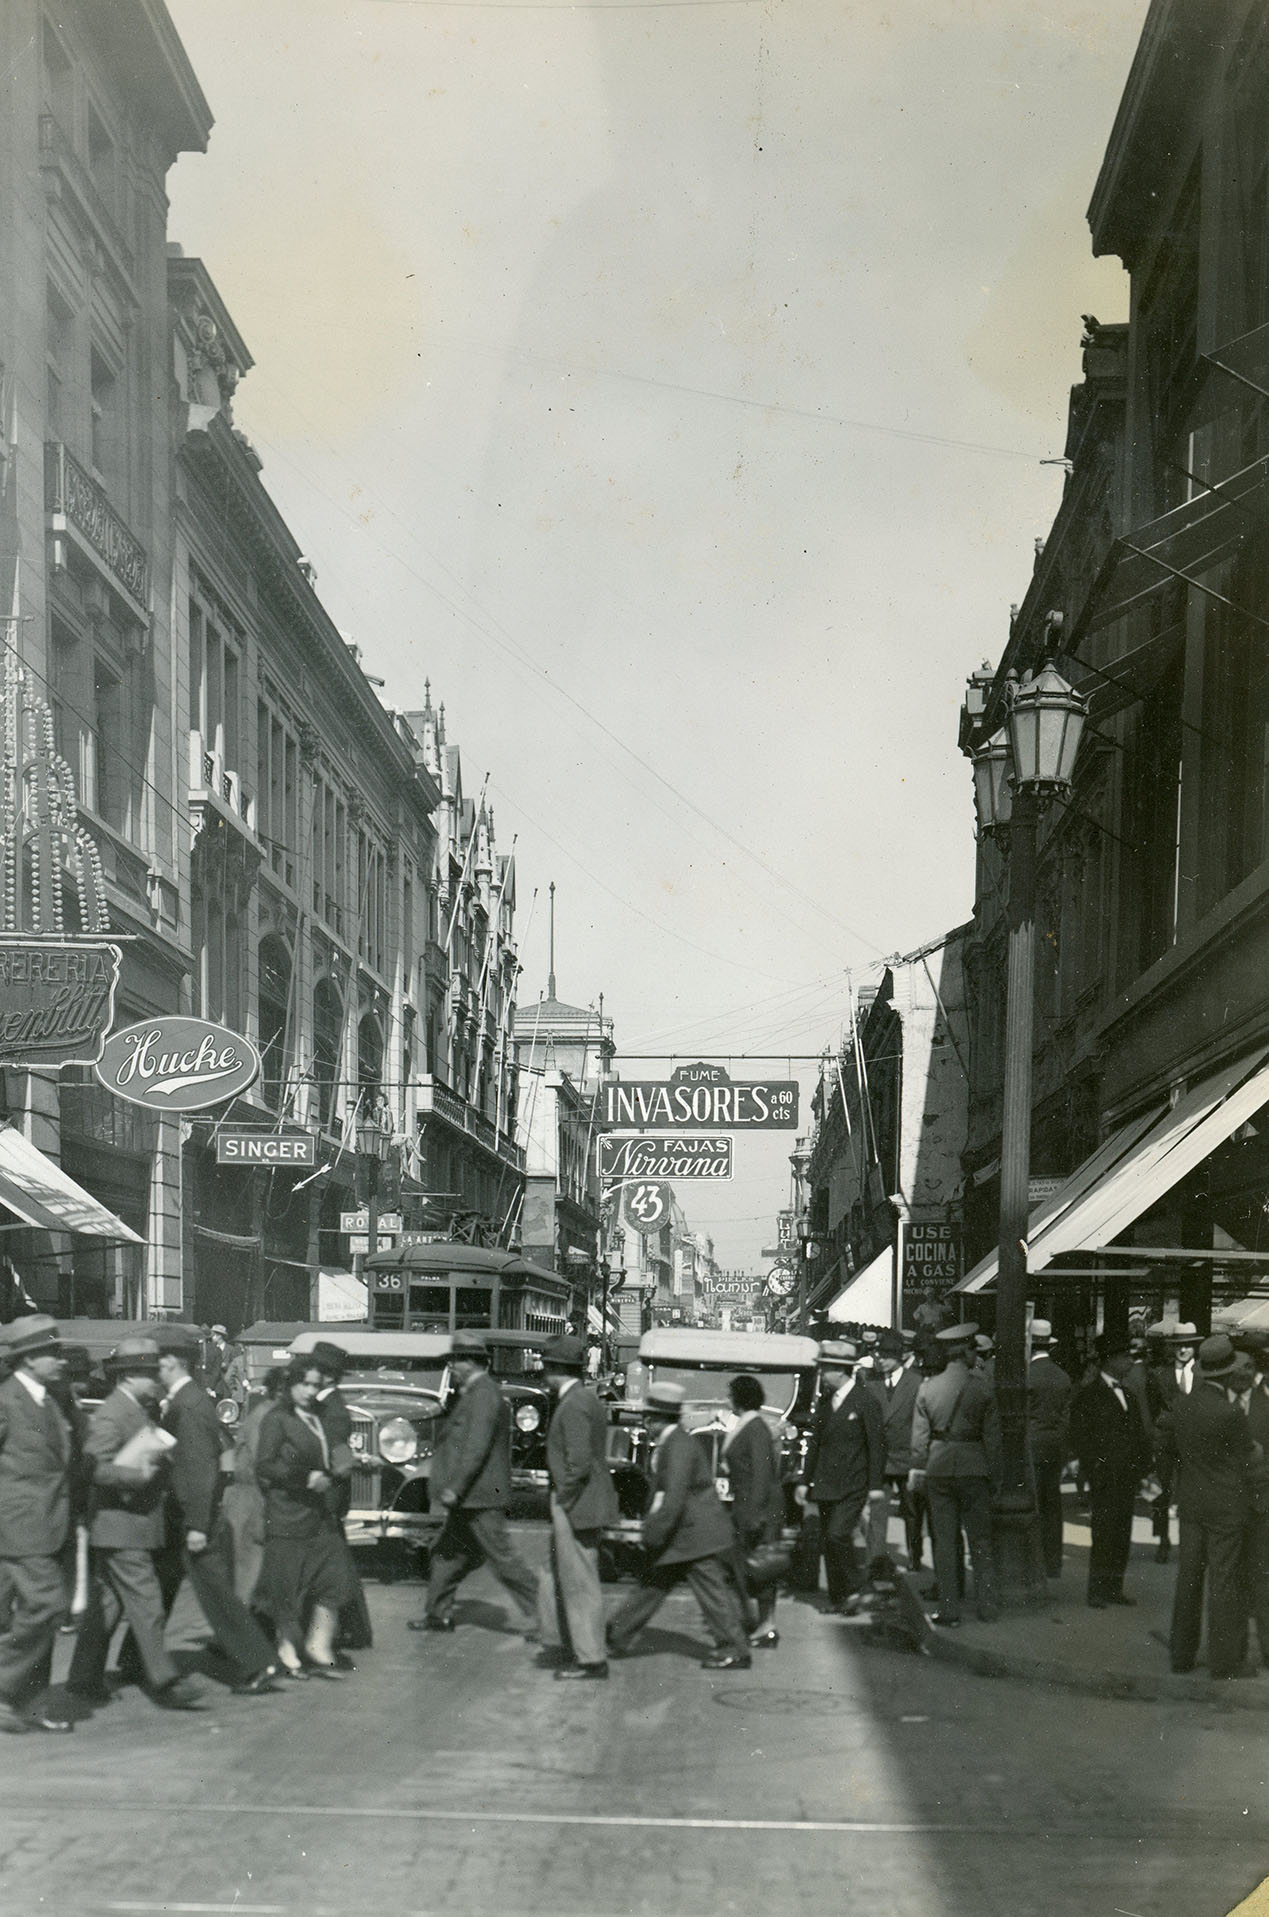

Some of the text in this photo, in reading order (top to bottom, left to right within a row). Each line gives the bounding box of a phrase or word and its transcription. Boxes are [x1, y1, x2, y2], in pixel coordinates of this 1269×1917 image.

[115, 1029, 243, 1087] Hucke
[679, 1070, 721, 1081] FUME
[607, 1086, 794, 1123] INVASORES a 60
[772, 1108, 791, 1121] cts
[225, 1139, 308, 1159] SINGER
[663, 1140, 729, 1153] FAJAS
[602, 1139, 729, 1176] Nirvana
[630, 1185, 664, 1223] 43
[344, 1216, 398, 1228] ROAL
[911, 1226, 952, 1239] USE
[905, 1242, 957, 1262] COCINA
[906, 1264, 956, 1277] A GAS
[378, 1272, 401, 1289] 36
